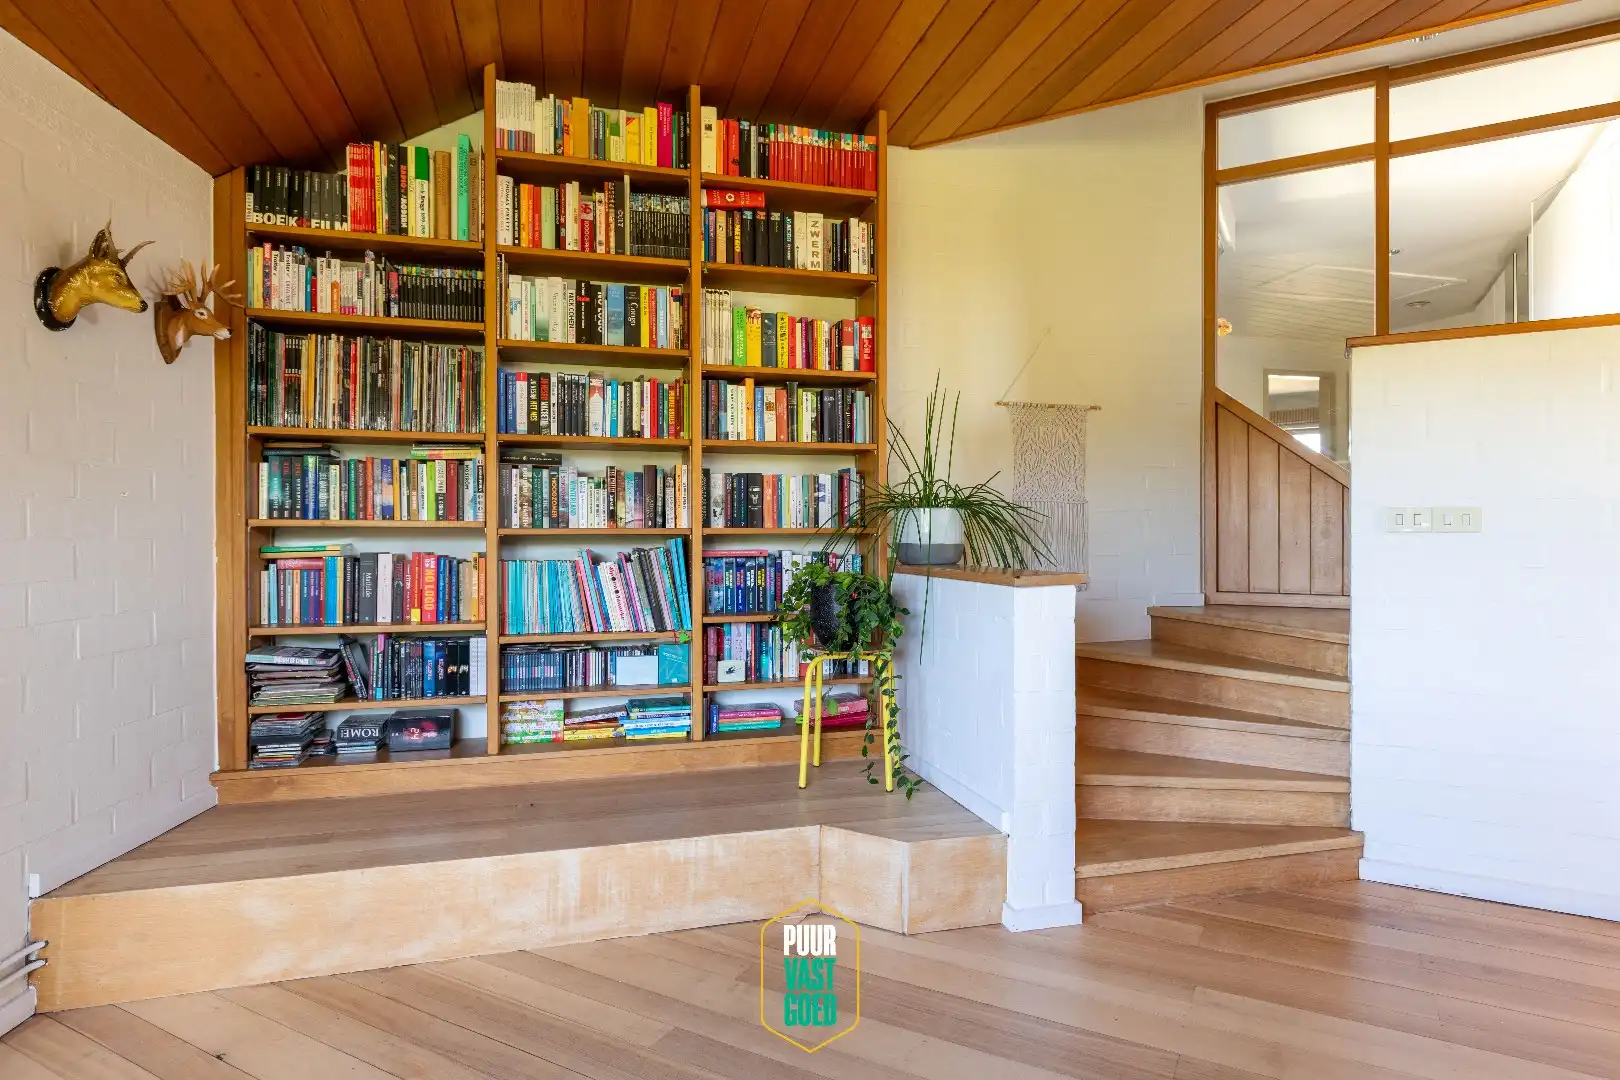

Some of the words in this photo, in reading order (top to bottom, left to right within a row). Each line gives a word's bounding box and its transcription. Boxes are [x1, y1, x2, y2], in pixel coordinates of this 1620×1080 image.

[311, 218, 350, 232] FILM
[810, 220, 821, 268] ZWERM
[628, 302, 638, 326] Congo
[425, 569, 436, 581] NO
[424, 585, 435, 610] LOGO
